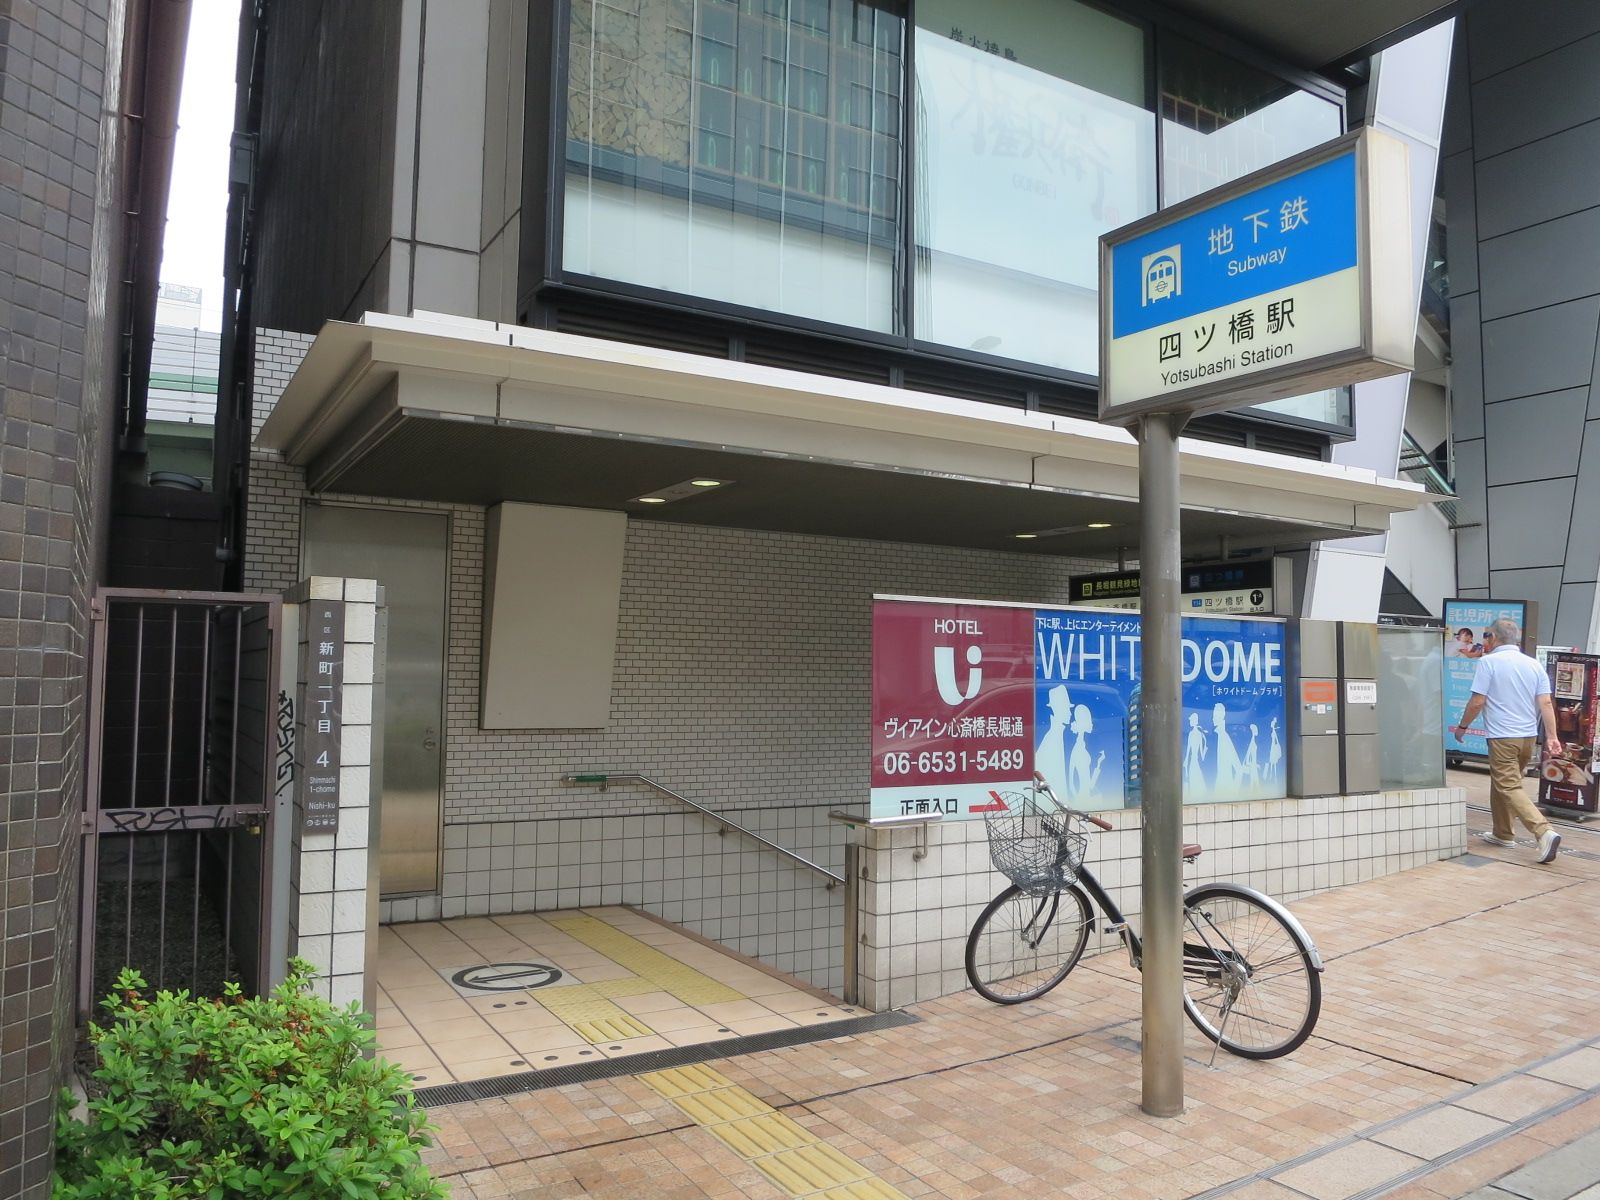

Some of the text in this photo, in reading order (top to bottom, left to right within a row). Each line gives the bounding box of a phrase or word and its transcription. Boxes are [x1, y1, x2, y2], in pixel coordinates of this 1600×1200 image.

[1207, 196, 1309, 257] 地下鉄
[1227, 246, 1288, 277] Subway
[1159, 297, 1296, 364] 四ツ橋駅
[1161, 342, 1294, 386] Yotsubashi Station
[933, 618, 983, 636] HOTEL
[1037, 631, 1282, 684] WHIT DOME
[316, 641, 335, 734] 新町一丁目
[884, 716, 1024, 739] ヴィアイン心斎橋長堀通
[316, 750, 330, 768] 4
[883, 749, 1024, 775] 06-6531-5489
[308, 801, 336, 811] Nishi-ku
[900, 798, 958, 815] 正面入口
